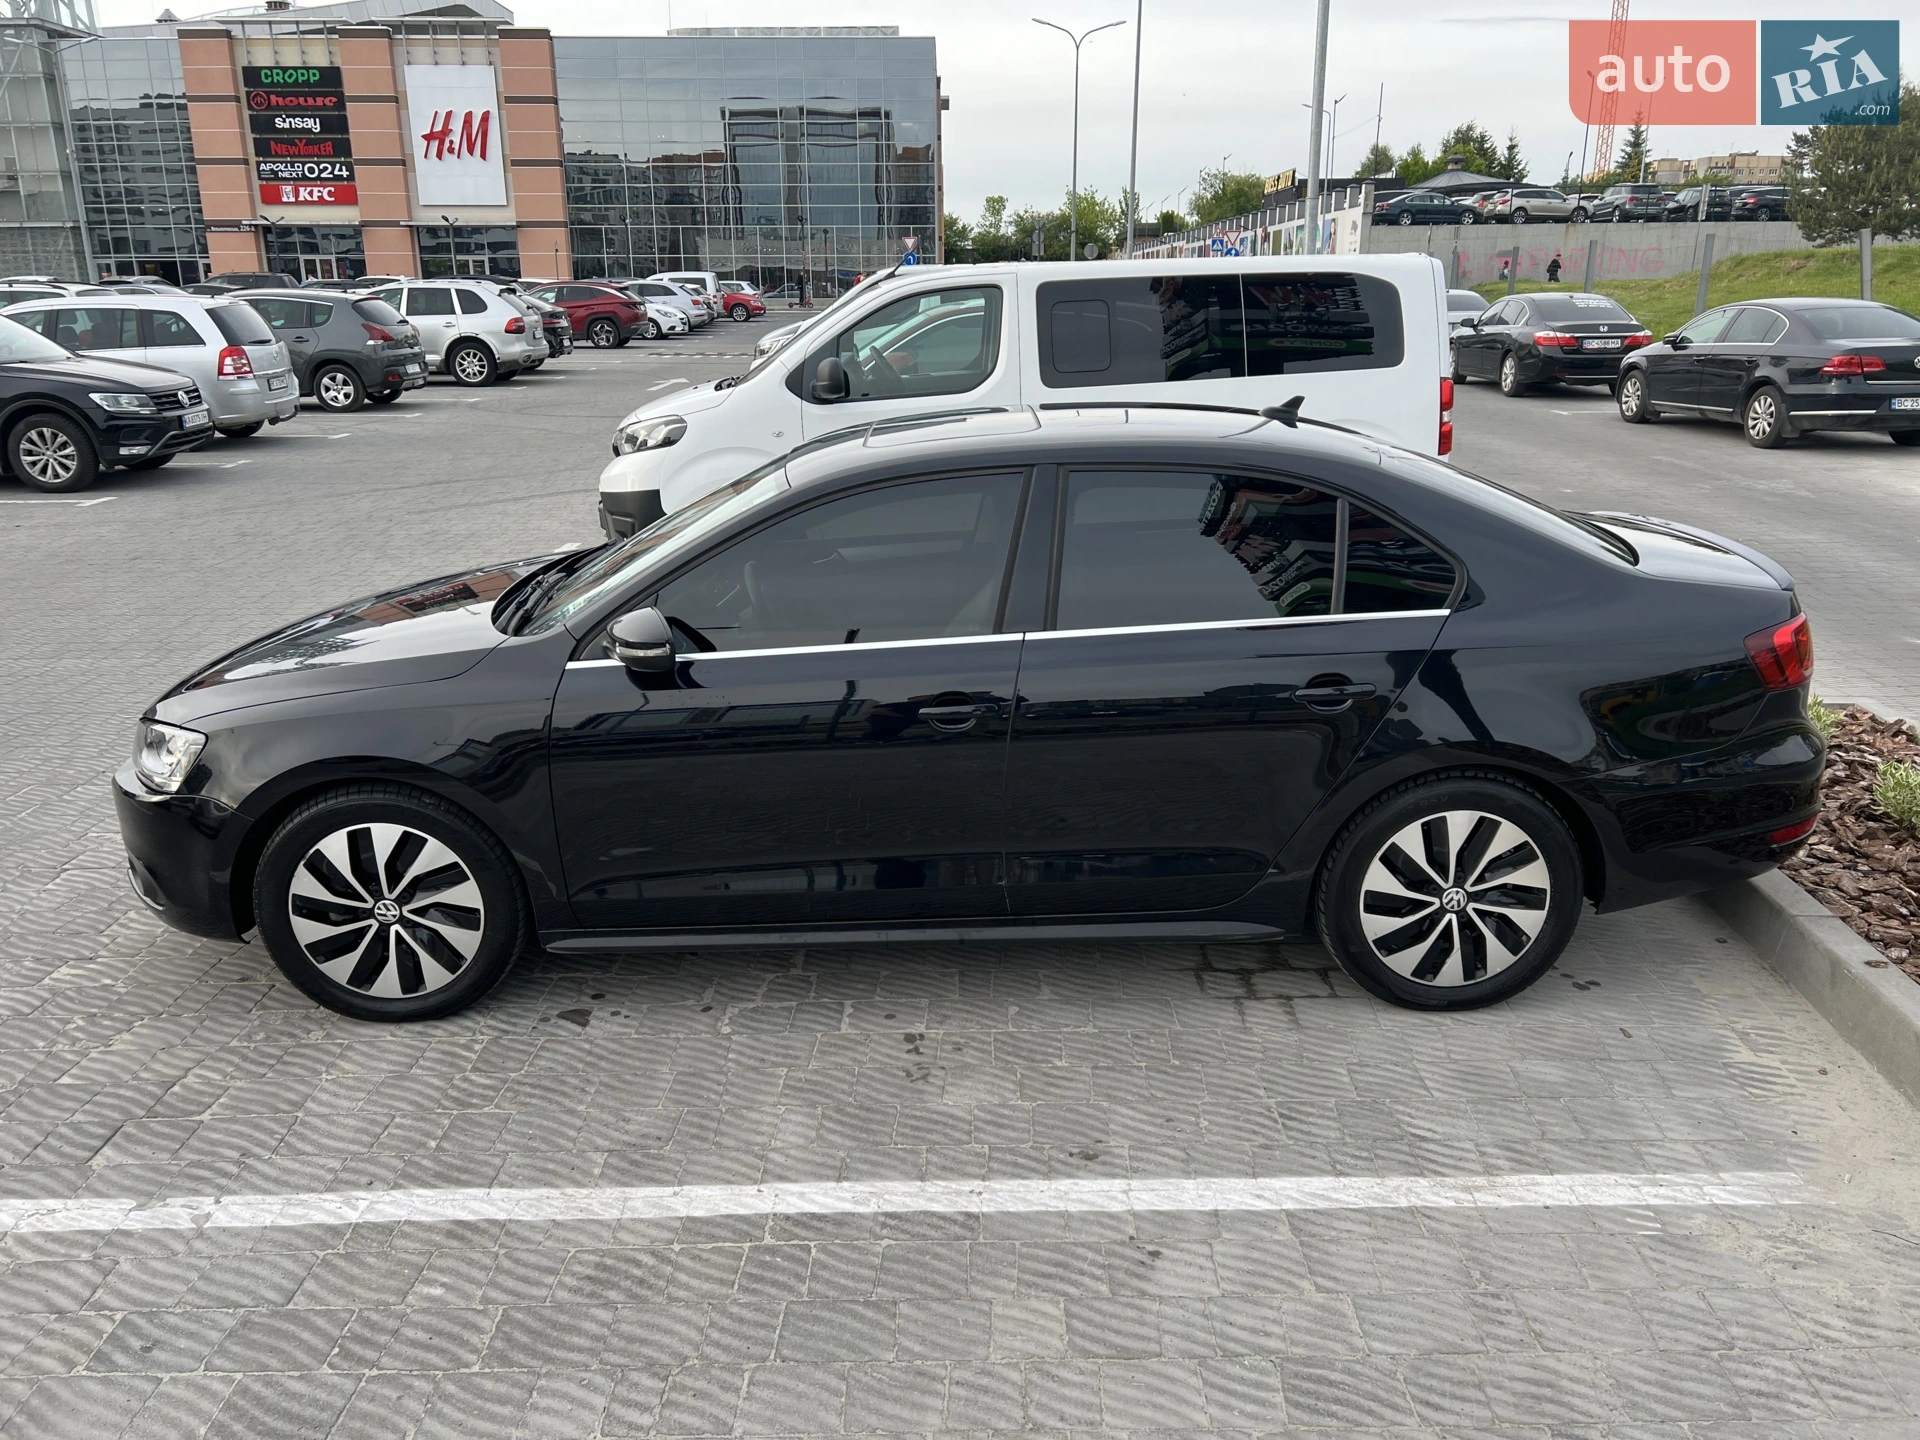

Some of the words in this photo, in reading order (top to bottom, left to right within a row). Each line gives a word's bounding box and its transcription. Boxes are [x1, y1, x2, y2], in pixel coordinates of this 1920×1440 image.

[260, 69, 320, 84] CROPP
[274, 114, 321, 133] sinsay
[421, 109, 491, 161] H&M
[259, 163, 303, 171] APOLLO
[297, 186, 335, 202] KFC
[1896, 398, 1909, 408] BC
